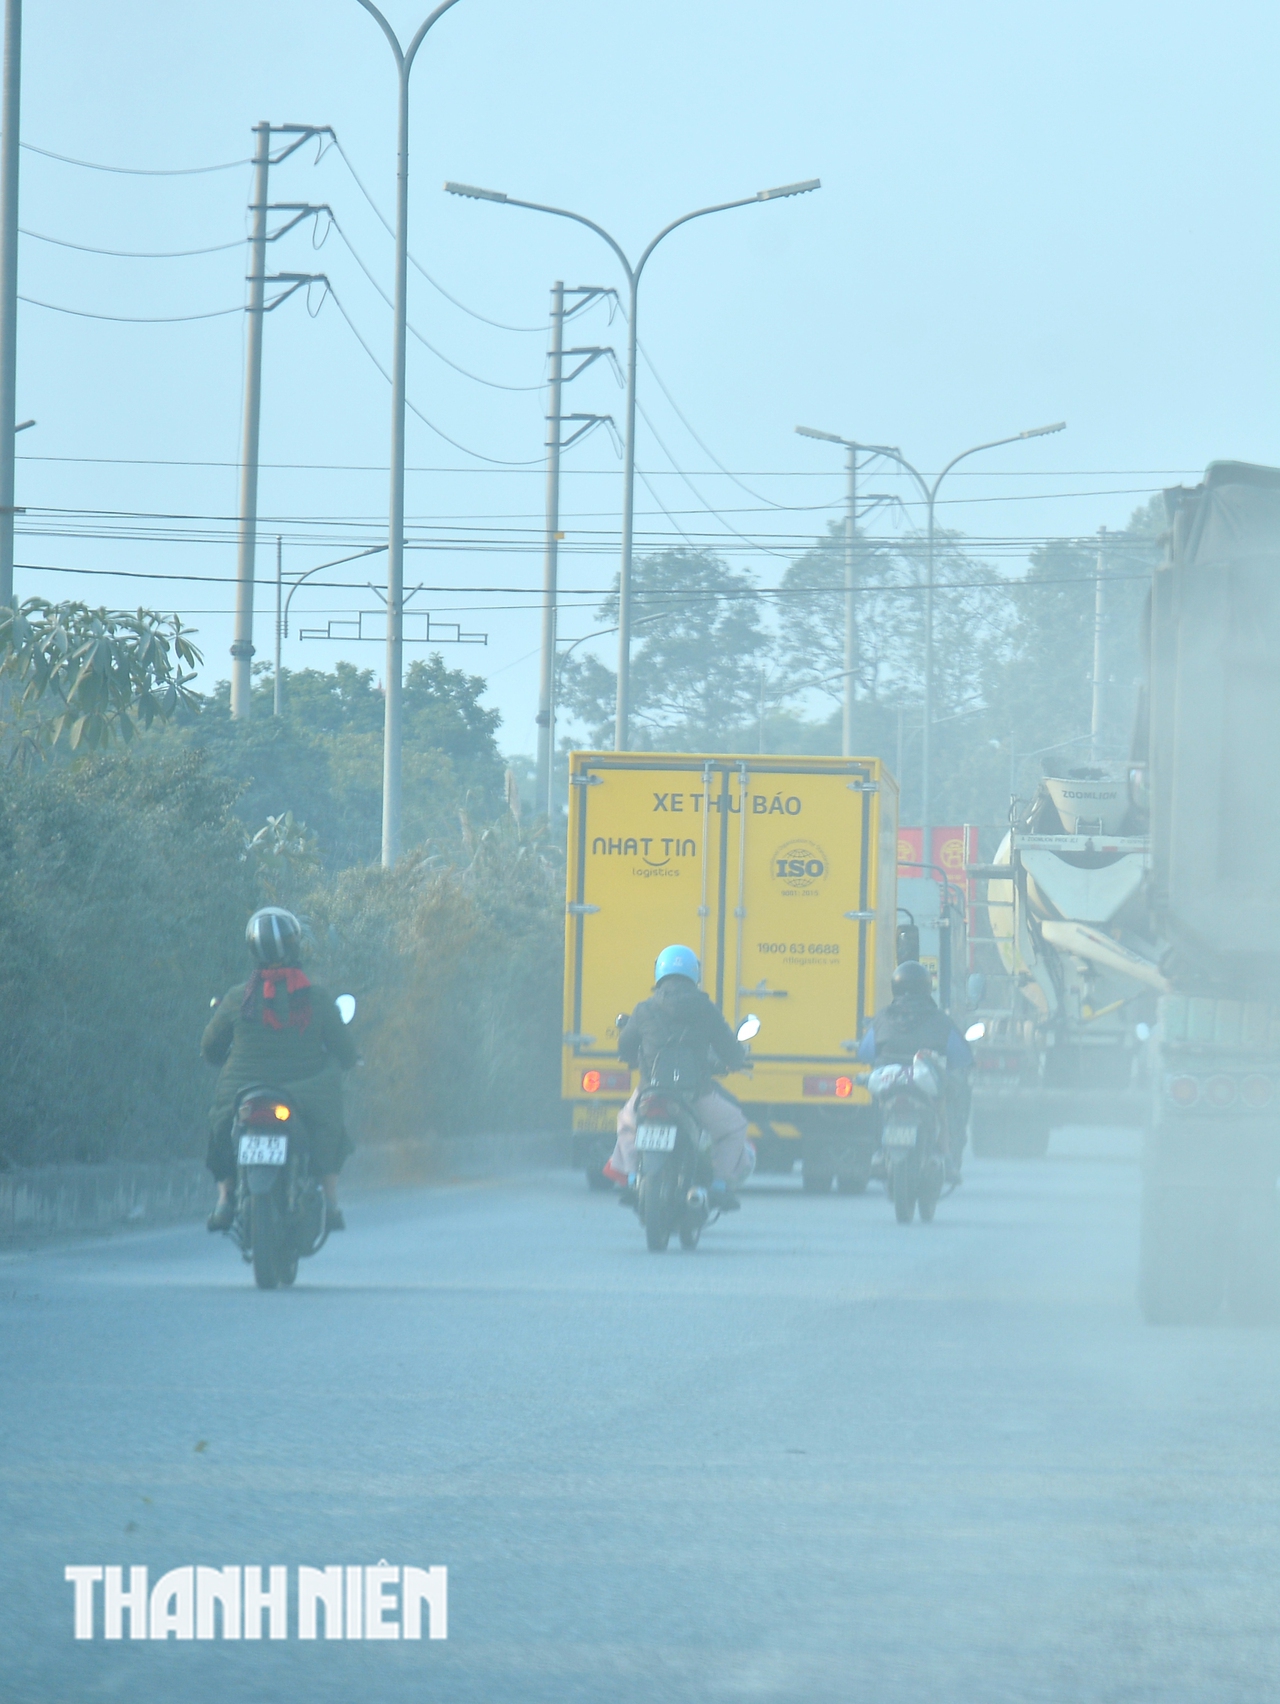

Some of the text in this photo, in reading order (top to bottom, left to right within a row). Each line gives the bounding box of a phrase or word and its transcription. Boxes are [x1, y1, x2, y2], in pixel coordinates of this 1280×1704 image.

[1062, 790, 1118, 800] ZOOMLION
[653, 791, 802, 815] XE THƯ BÁO
[632, 867, 680, 878] logistics
[776, 859, 824, 877] ISO
[758, 943, 840, 955] 1900 63 6688
